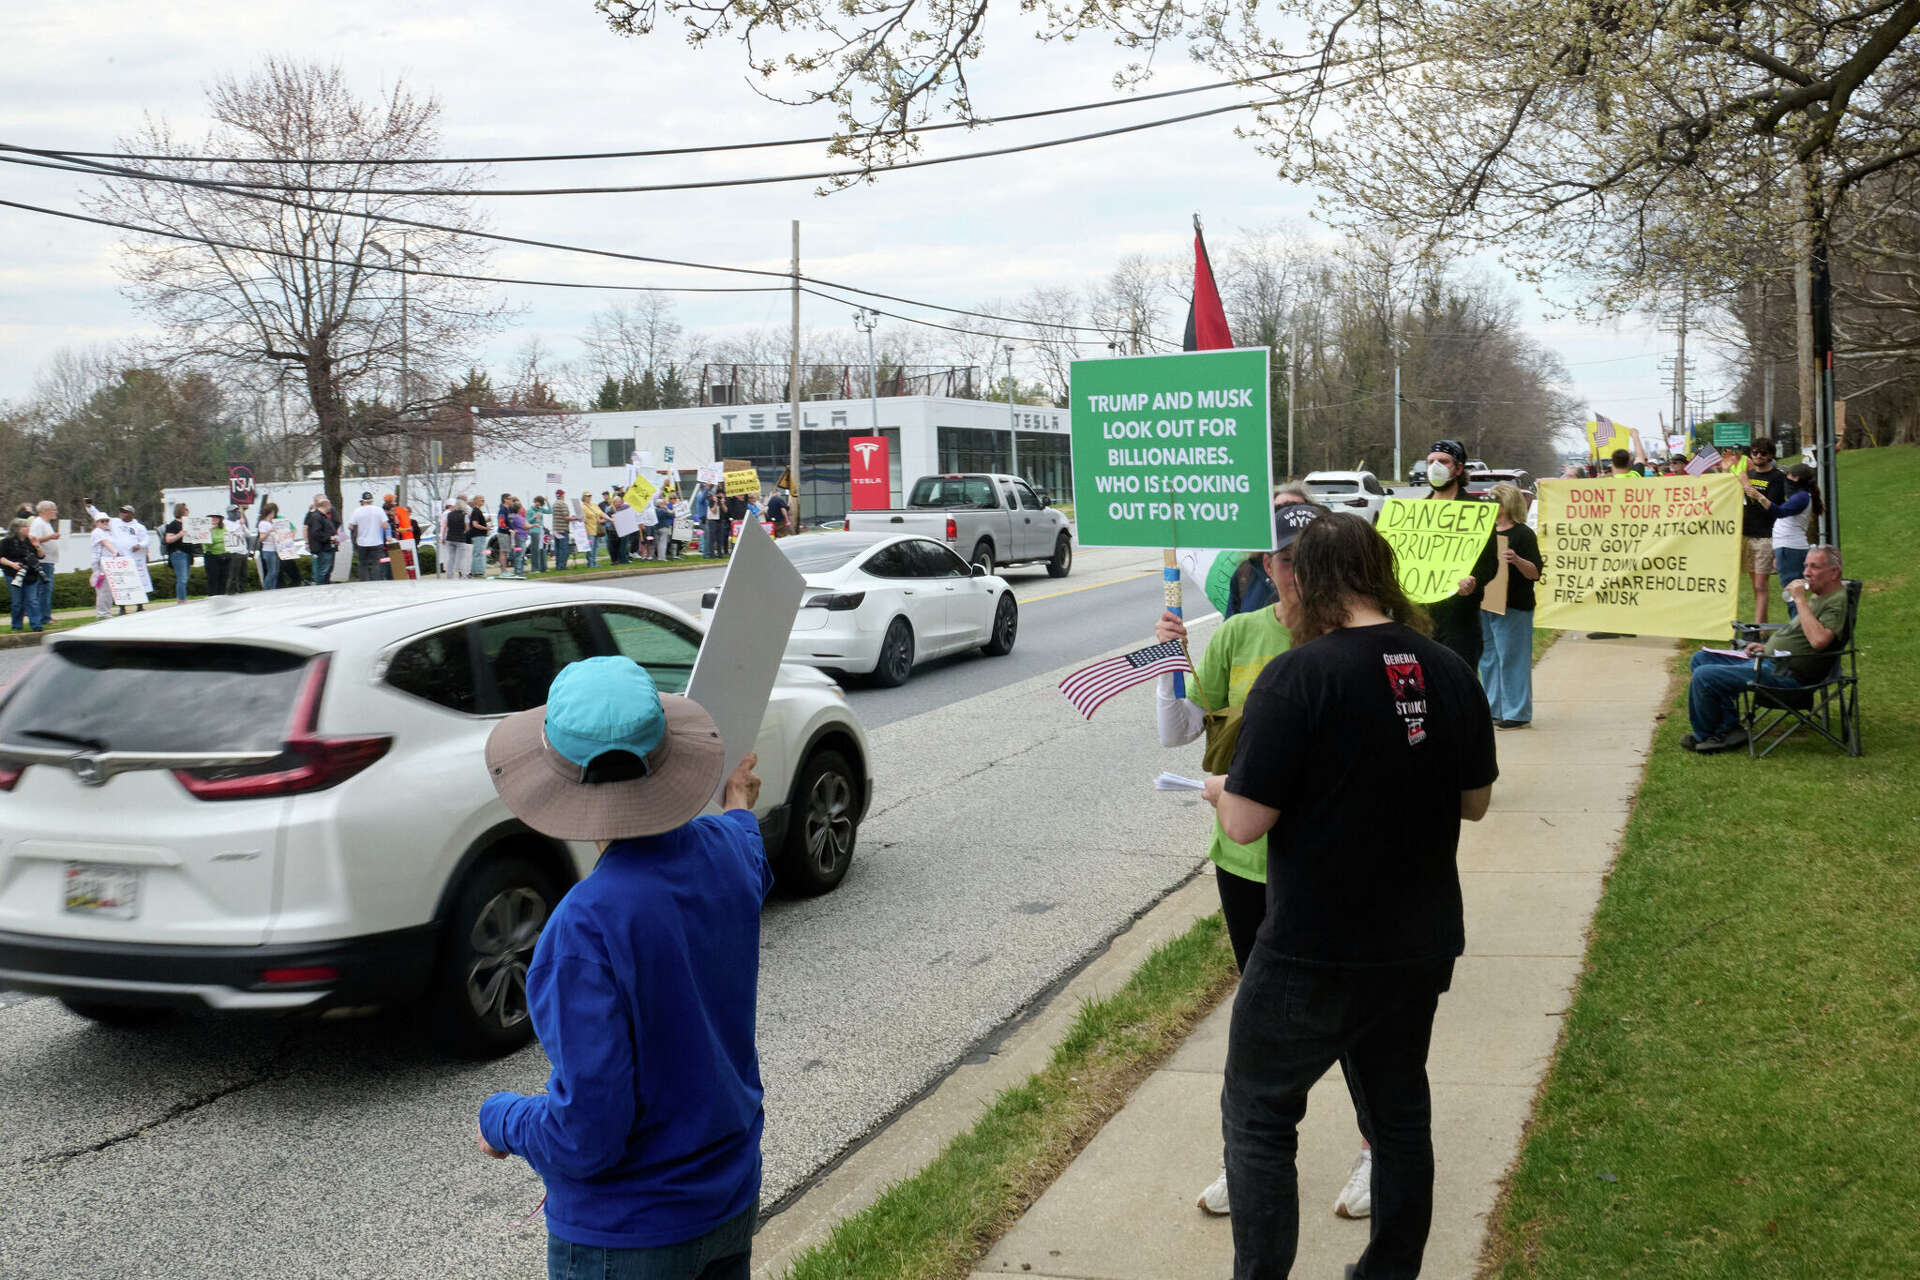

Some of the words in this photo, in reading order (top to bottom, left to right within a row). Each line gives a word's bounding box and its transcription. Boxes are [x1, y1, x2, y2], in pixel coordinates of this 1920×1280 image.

[1088, 393, 1148, 412] TRUMP
[1152, 391, 1193, 410] AND
[1197, 388, 1253, 408] MUSK
[721, 410, 848, 431] TESLA
[1014, 413, 1059, 430] TESLA
[1103, 421, 1153, 439] LOOK
[1156, 419, 1194, 437] OUT
[1198, 418, 1237, 437] FOR
[1107, 446, 1234, 467] BILLIONAIRES.
[1095, 475, 1140, 494] WHO
[1144, 475, 1159, 493] IS
[1162, 474, 1250, 494] LOOKING
[1570, 488, 1617, 503] DONT
[1624, 487, 1656, 503] BUY
[1664, 485, 1709, 502] TESLA
[1108, 503, 1145, 520] OUT
[1149, 503, 1185, 521] FOR
[1188, 503, 1240, 522] YOU?
[1389, 500, 1490, 532] DANGER
[1566, 504, 1612, 519] DUMP
[1619, 504, 1661, 519] YOUR
[1666, 501, 1714, 518] STOCK
[1556, 522, 1604, 537] ELON
[1610, 522, 1649, 537] STOP
[1652, 519, 1736, 537] ATTACKING
[1557, 537, 1591, 552] OUR
[1600, 538, 1642, 554] GOVT
[1556, 555, 1598, 570] SHUT
[1602, 557, 1638, 572] DOWN
[1641, 556, 1688, 571] DOGE
[1401, 567, 1460, 595] ONE
[1556, 574, 1594, 589] TSLA
[1601, 575, 1727, 593] SHAREHOLDERS
[1554, 590, 1584, 603] FIRE
[1595, 591, 1640, 606] MUSK
